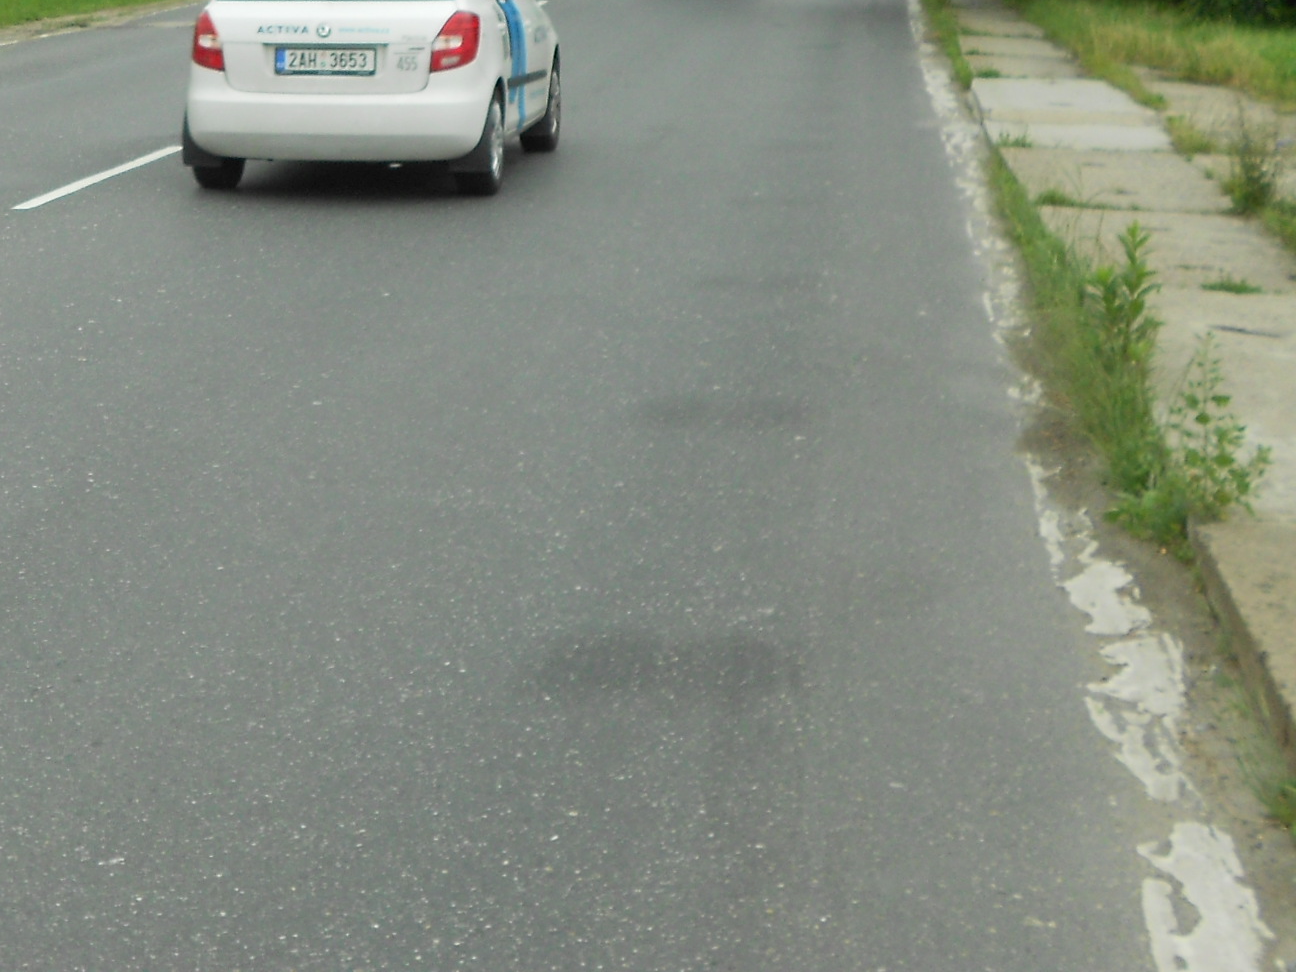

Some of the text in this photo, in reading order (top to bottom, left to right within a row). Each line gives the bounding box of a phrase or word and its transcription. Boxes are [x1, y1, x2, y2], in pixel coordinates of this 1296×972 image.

[257, 25, 309, 34] ACTIVA
[289, 52, 368, 69] 2AH 3653
